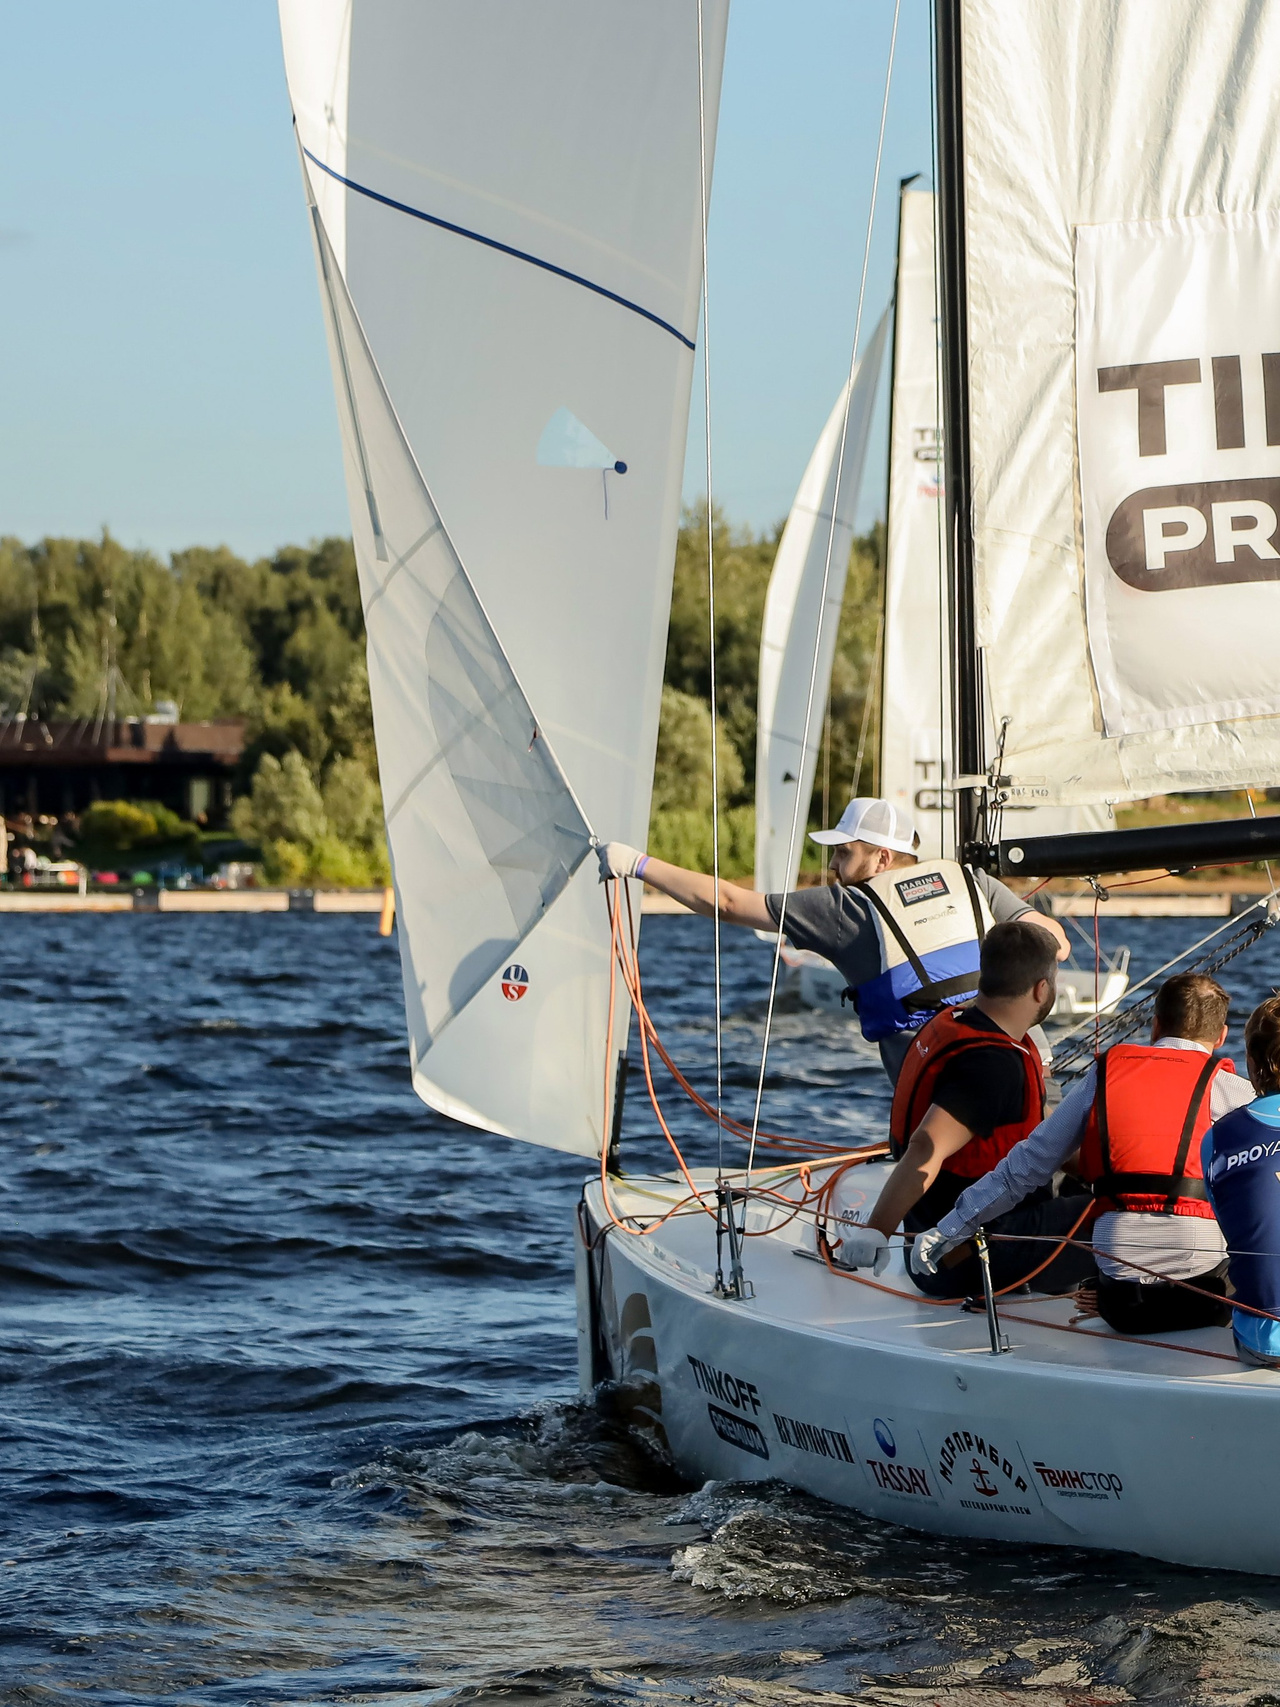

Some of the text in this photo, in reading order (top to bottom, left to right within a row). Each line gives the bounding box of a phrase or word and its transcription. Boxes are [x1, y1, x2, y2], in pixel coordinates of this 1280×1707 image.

[899, 875, 941, 892] MARINE
[687, 1354, 761, 1416] TINKOFF
[867, 1460, 932, 1496] TASSAY
